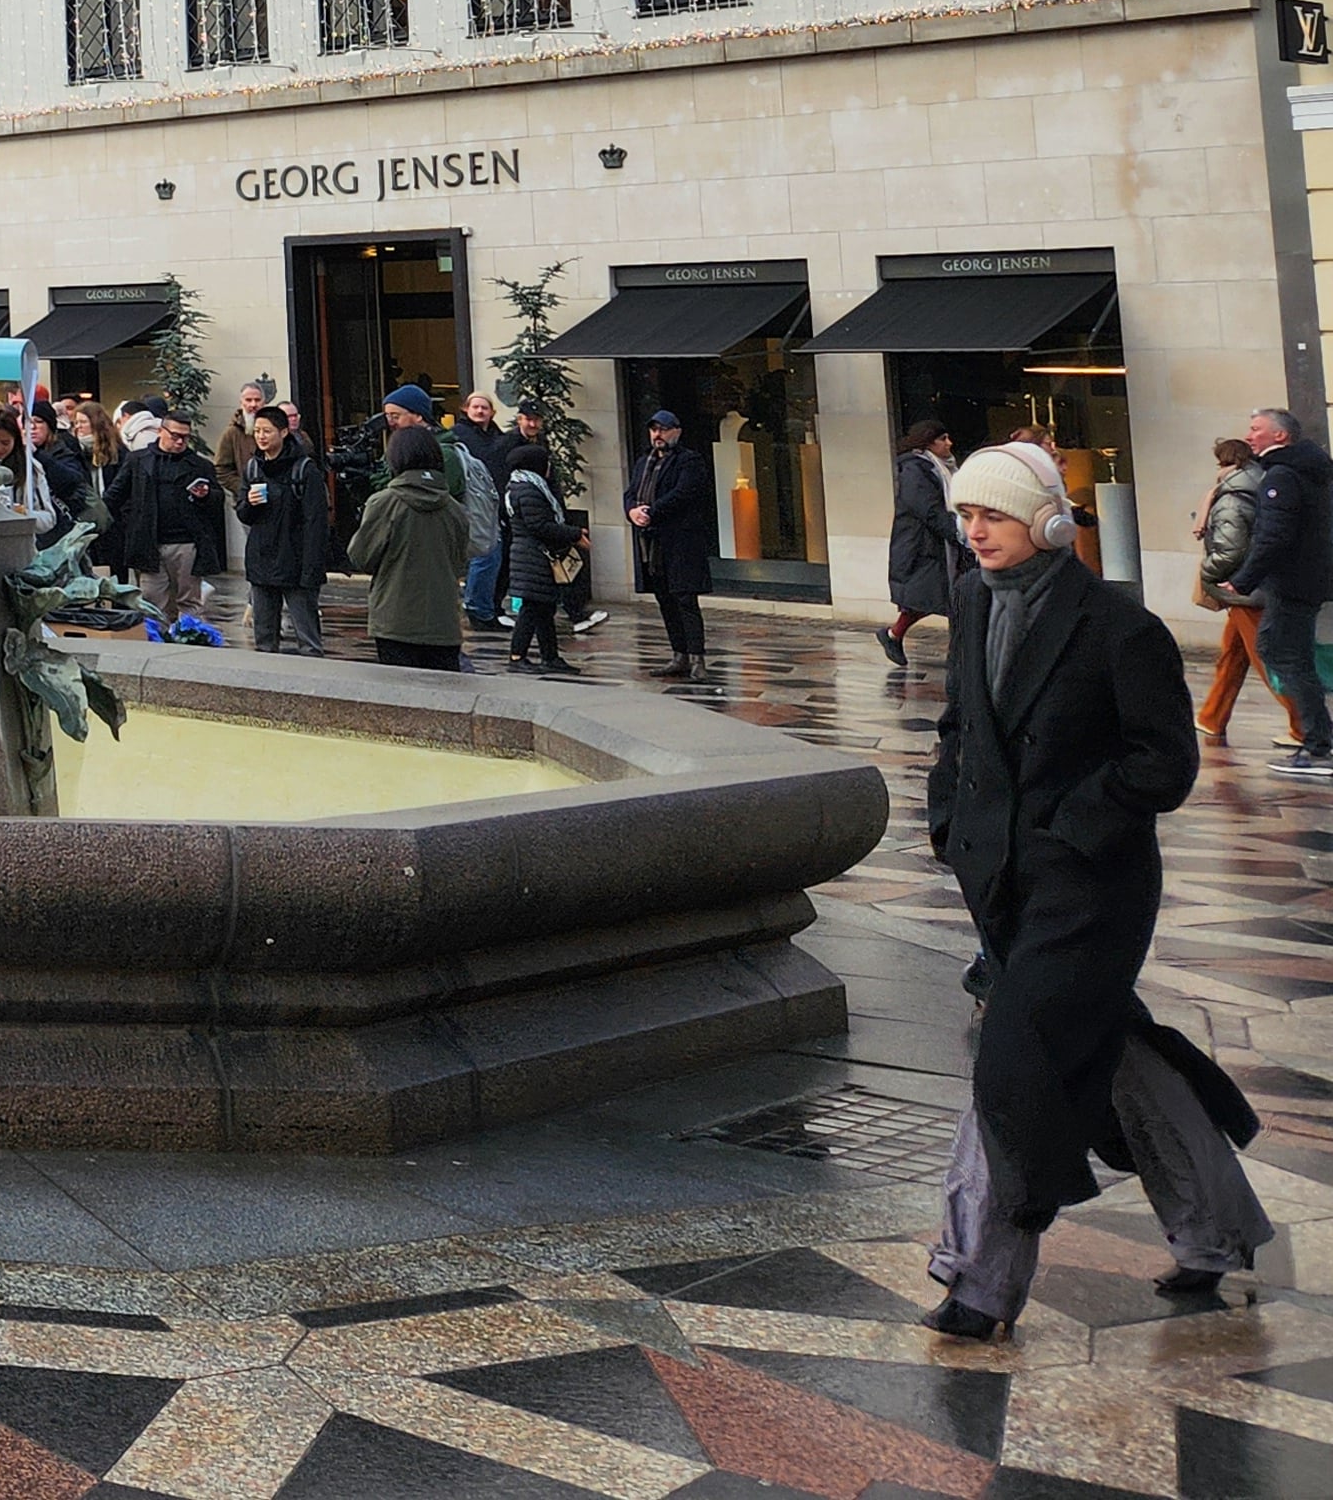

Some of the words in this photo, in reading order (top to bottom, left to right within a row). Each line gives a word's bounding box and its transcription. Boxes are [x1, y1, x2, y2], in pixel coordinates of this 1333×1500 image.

[235, 160, 360, 202] GEORG
[376, 148, 521, 202] JENSEN
[940, 258, 993, 272] GEORG
[996, 256, 1051, 272] JENSEN
[665, 267, 709, 281] GEORG
[711, 266, 757, 281] JENSEN
[86, 288, 115, 300] GEORG
[116, 287, 146, 301] JENSEN
